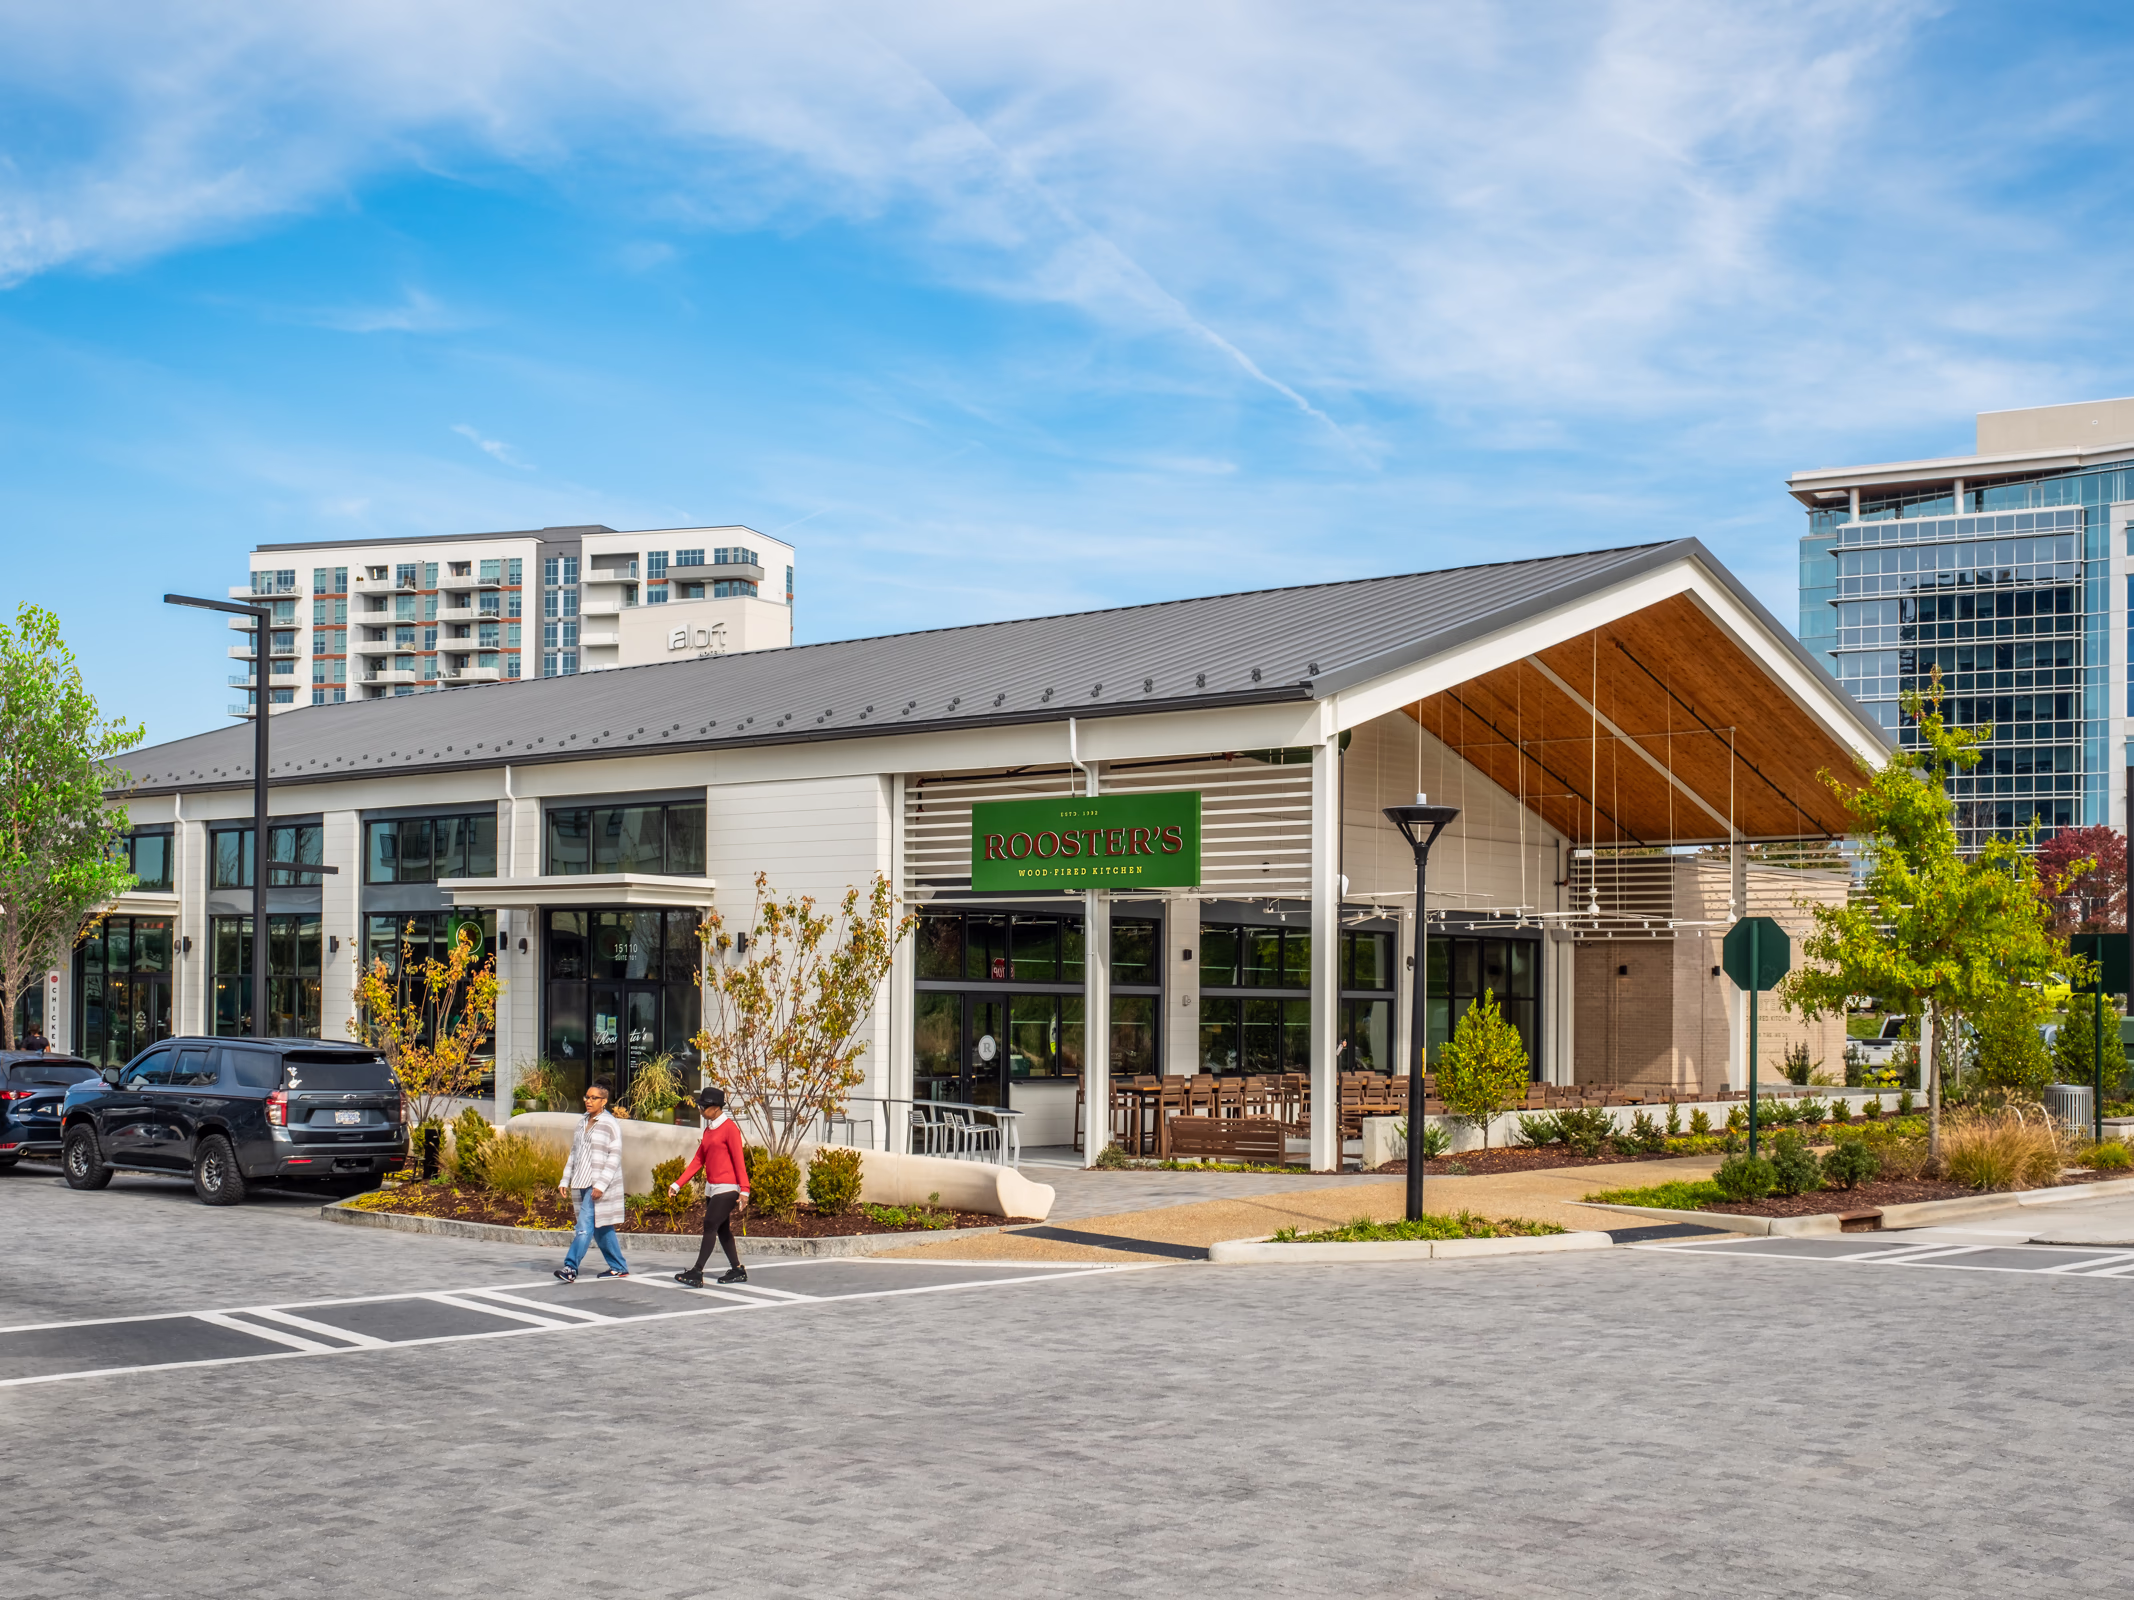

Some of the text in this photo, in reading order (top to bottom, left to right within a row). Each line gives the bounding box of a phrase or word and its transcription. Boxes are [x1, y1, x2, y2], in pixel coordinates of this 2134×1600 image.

[668, 622, 727, 650] aloft
[983, 826, 1183, 860] ROOSTER'S
[1092, 866, 1143, 875] KITCHEN
[614, 943, 638, 953] 15110
[983, 1043, 991, 1053] R
